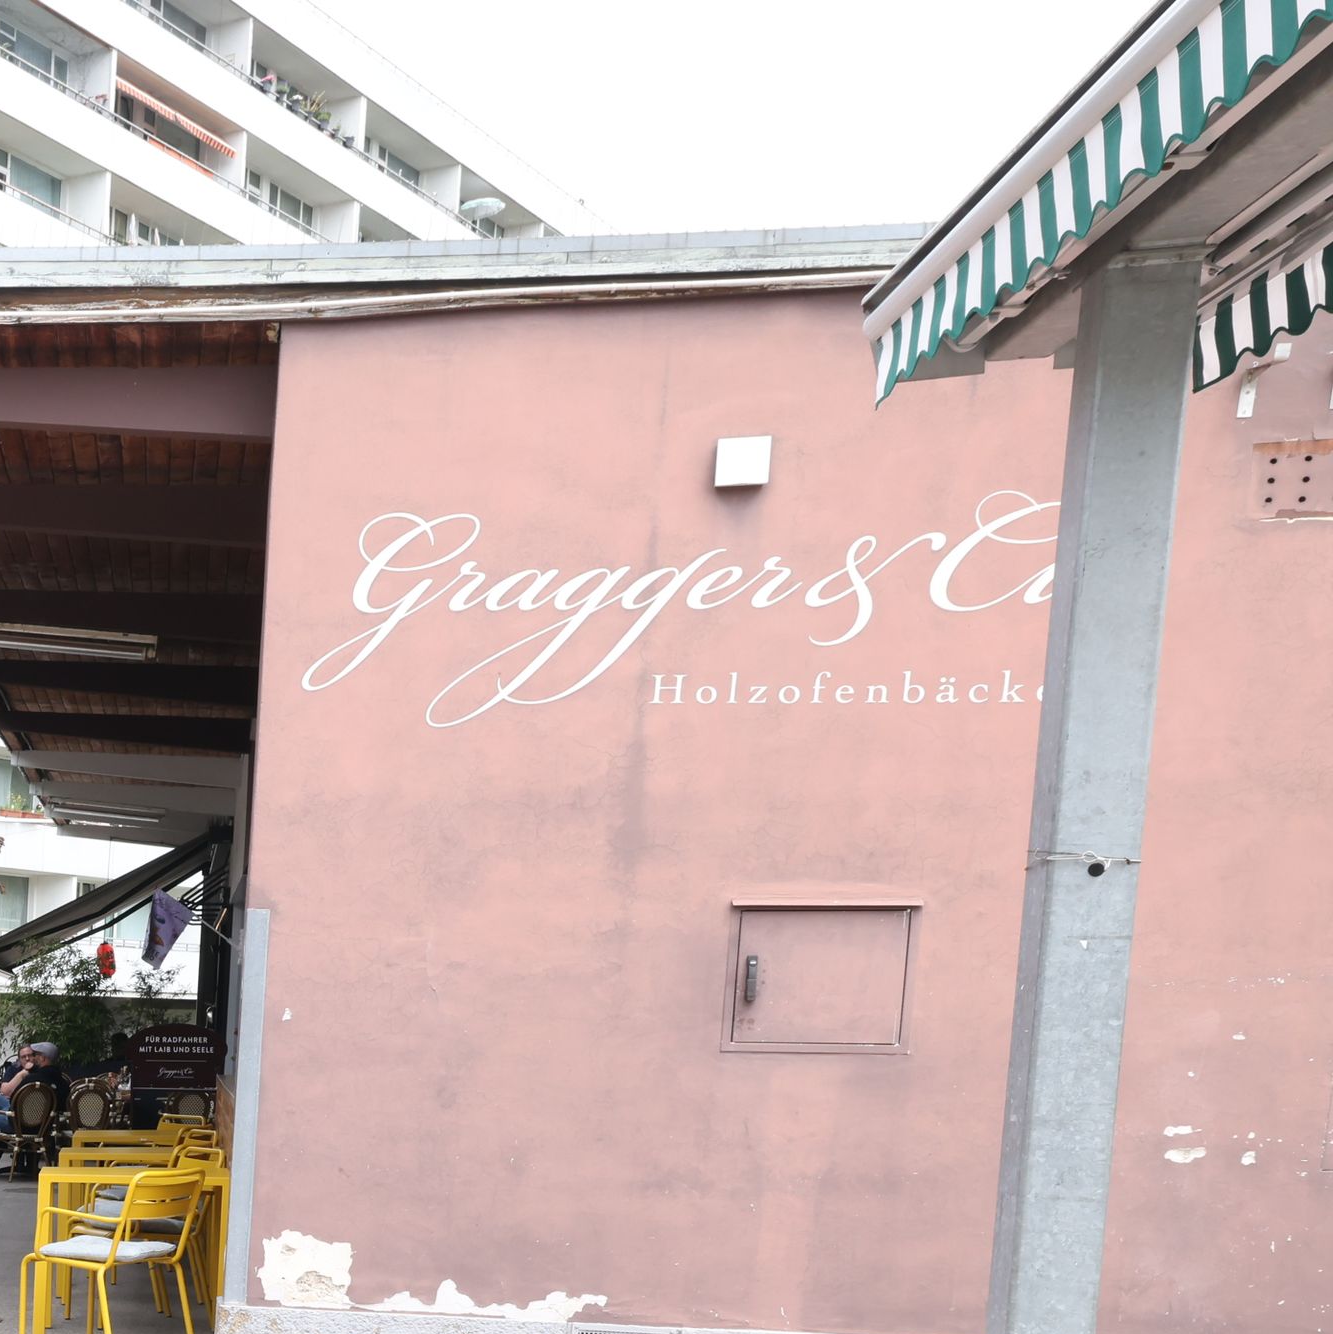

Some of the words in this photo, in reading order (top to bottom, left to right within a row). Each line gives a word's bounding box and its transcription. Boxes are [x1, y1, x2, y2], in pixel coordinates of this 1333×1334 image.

[300, 511, 804, 729] Gragger
[803, 531, 947, 648] &
[145, 1035, 160, 1044] FÜR
[162, 1036, 208, 1044] RADFAHRER
[192, 1046, 214, 1054] SEELE
